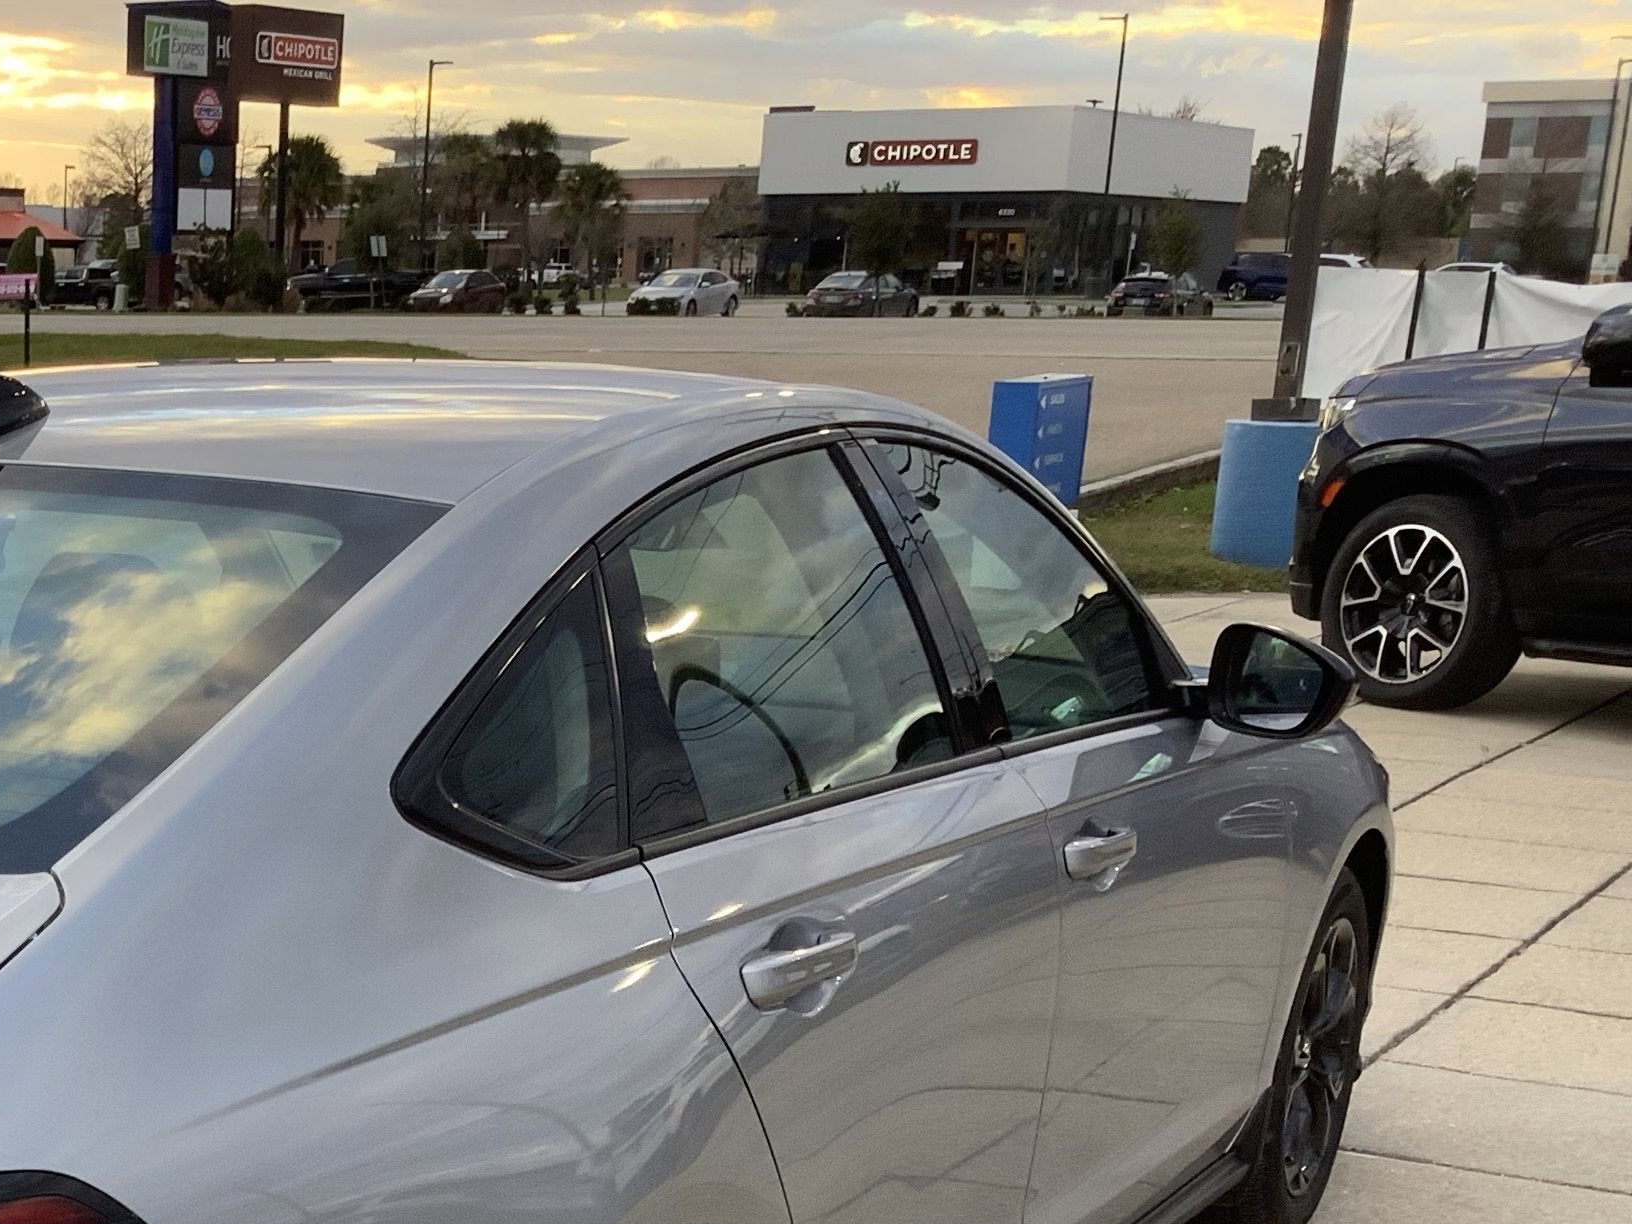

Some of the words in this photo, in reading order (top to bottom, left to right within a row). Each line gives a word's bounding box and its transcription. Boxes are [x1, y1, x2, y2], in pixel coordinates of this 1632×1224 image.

[171, 38, 206, 58] Express
[275, 40, 335, 61] CHIPOTLE
[282, 67, 313, 78] MEXICAN
[314, 70, 333, 80] GRILL
[873, 143, 972, 161] CHIPOTLE
